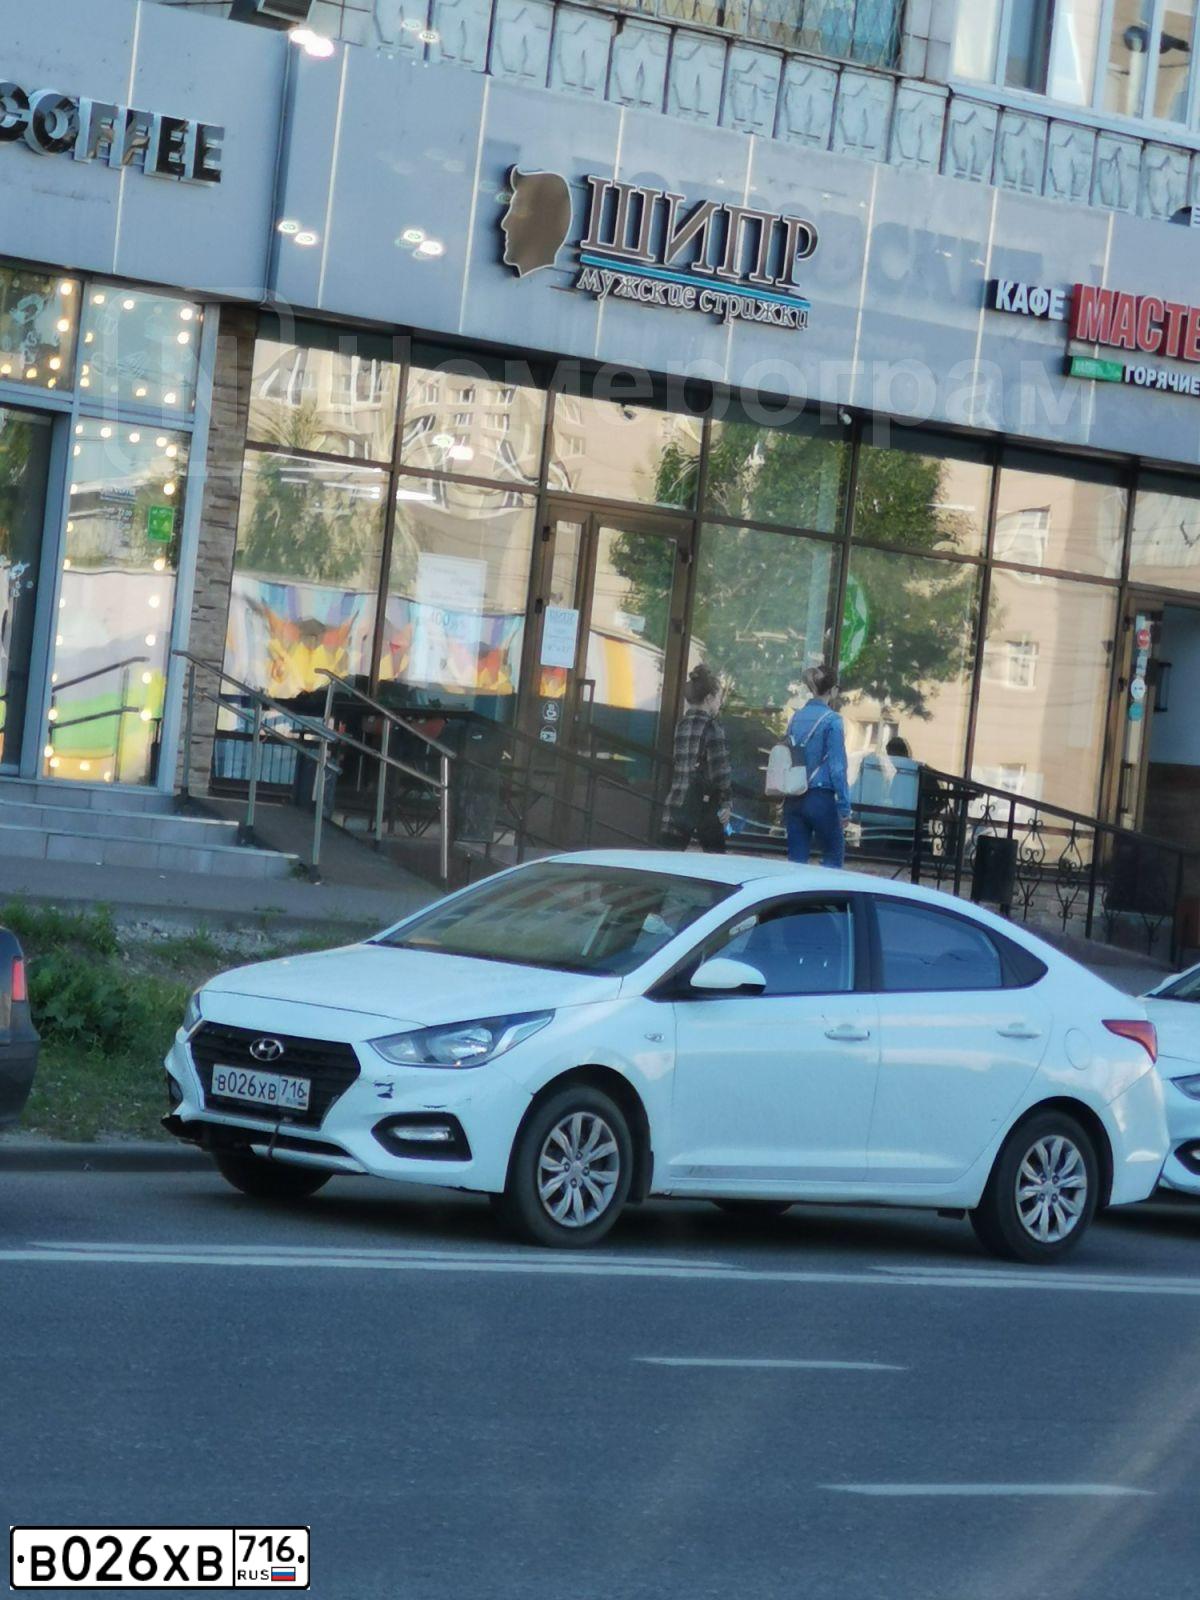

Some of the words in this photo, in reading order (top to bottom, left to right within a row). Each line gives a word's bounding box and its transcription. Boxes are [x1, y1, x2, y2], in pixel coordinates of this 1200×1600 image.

[0, 80, 225, 187] COFFEE
[580, 175, 819, 288] ШИПР
[577, 267, 696, 309] мужские
[699, 289, 809, 331] стрижки
[995, 279, 1066, 321] КАФЕ
[1125, 365, 1200, 395] ГОРЯЧИЕ
[217, 1071, 277, 1100] В026ХВ
[281, 1079, 305, 1098] 716
